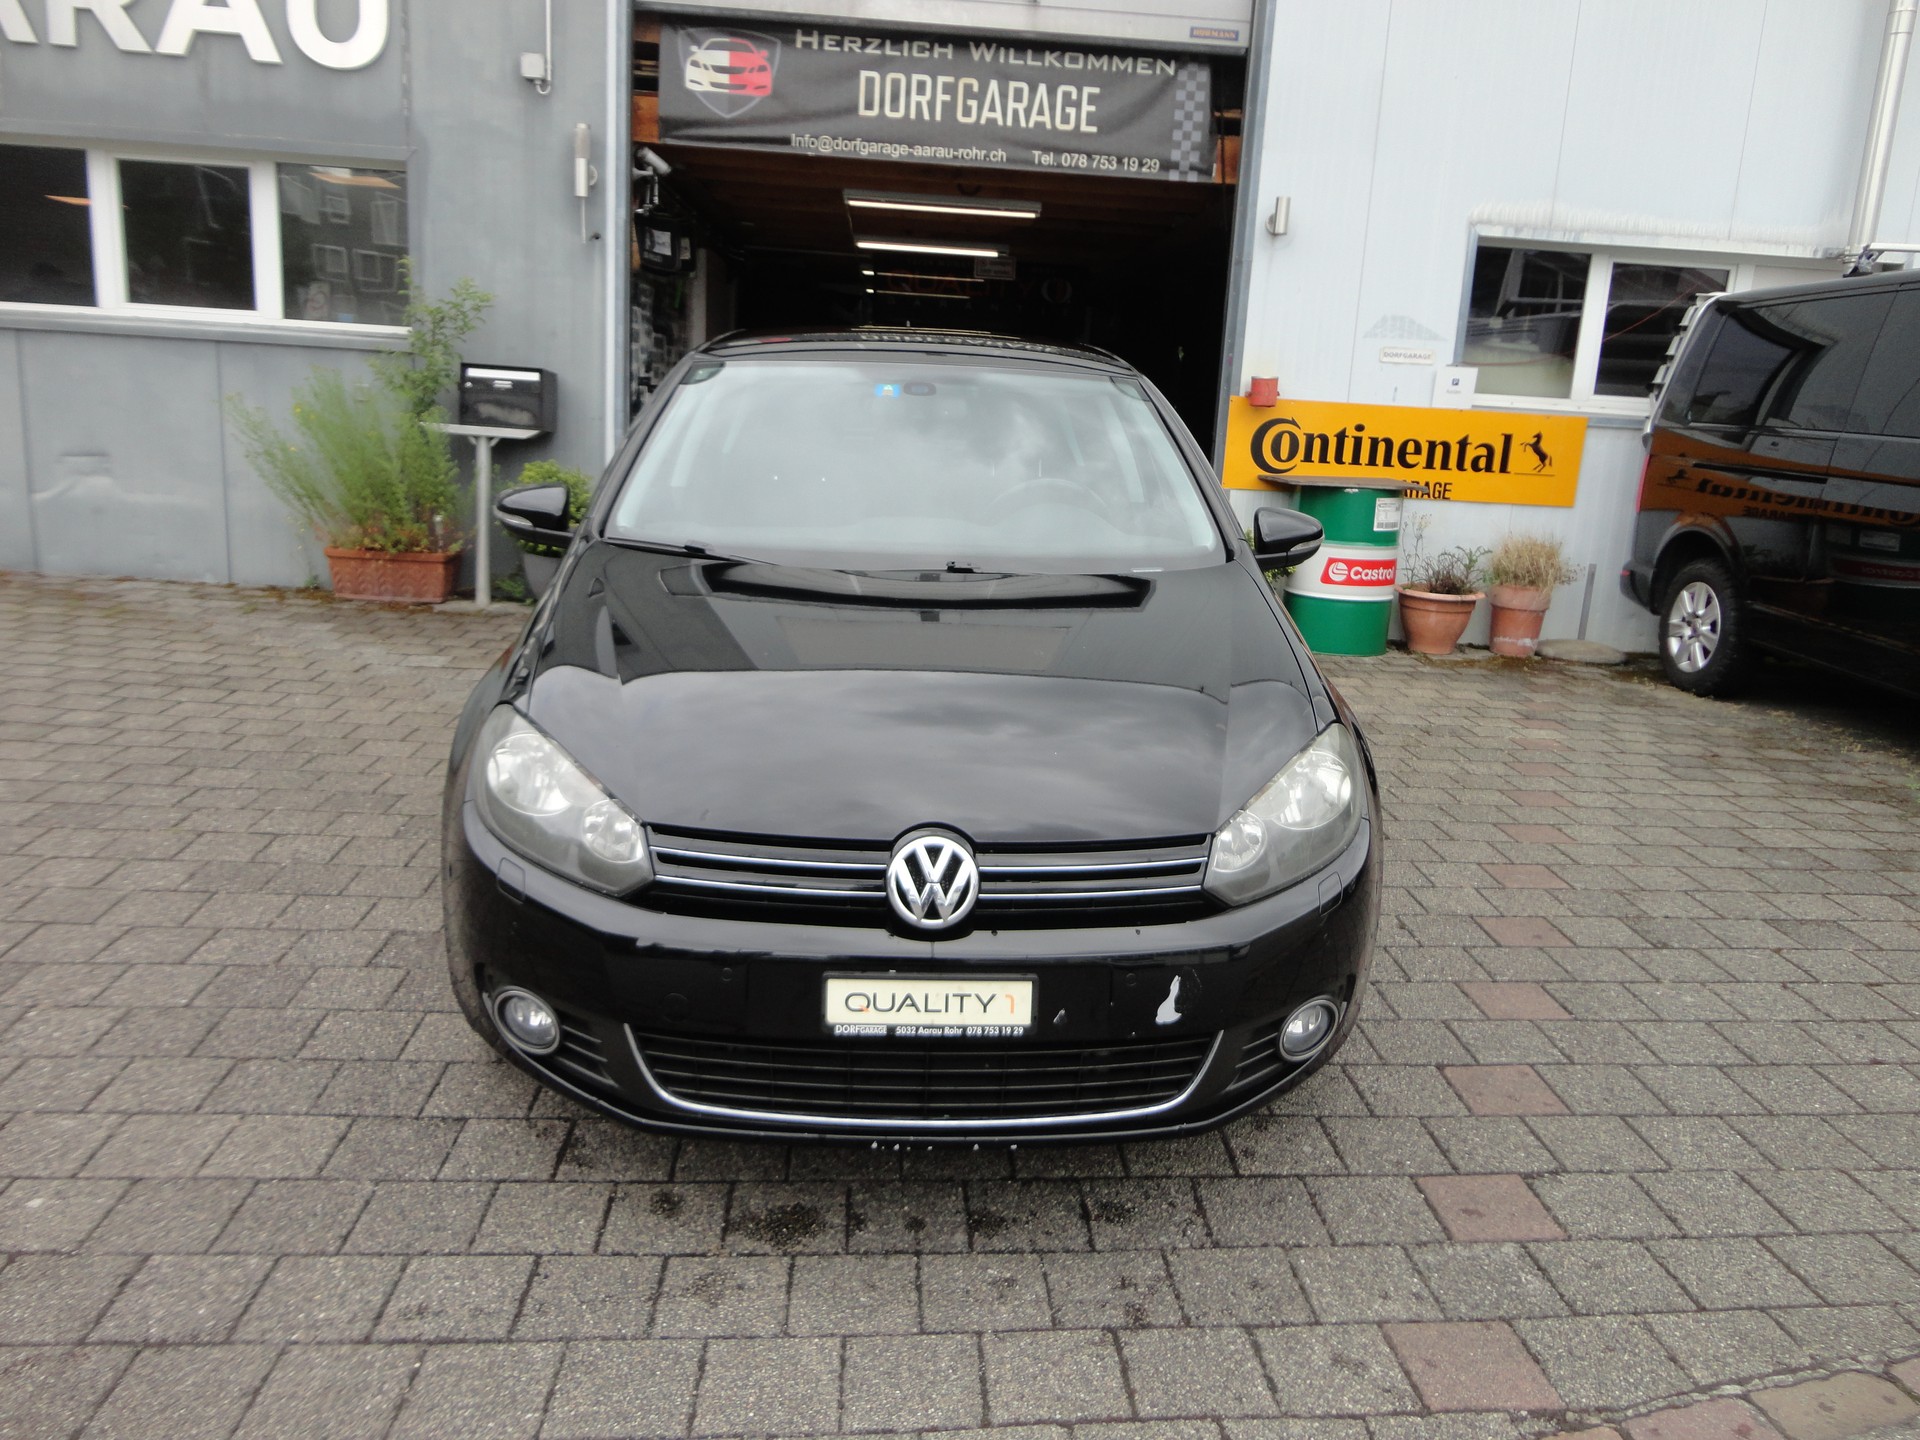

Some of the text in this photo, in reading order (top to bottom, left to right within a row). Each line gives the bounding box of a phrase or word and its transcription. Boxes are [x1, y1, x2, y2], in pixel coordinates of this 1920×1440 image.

[857, 69, 1101, 133] DORFGARAGE
[790, 133, 1007, 164] Info@dorfgarage-aarau-rohr.ch
[1031, 150, 1160, 174] Tel. 078 753 19 29
[1250, 416, 1514, 475] Continental
[1350, 565, 1395, 581] Castrol
[844, 992, 997, 1014] QUALITY
[896, 1025, 917, 1035] 5032
[918, 1025, 943, 1035] Aarau
[944, 1025, 963, 1035] Rohr
[967, 1026, 982, 1035] 078
[984, 1026, 1000, 1035] 753
[1002, 1026, 1012, 1035] 19
[1013, 1026, 1024, 1035] 29
